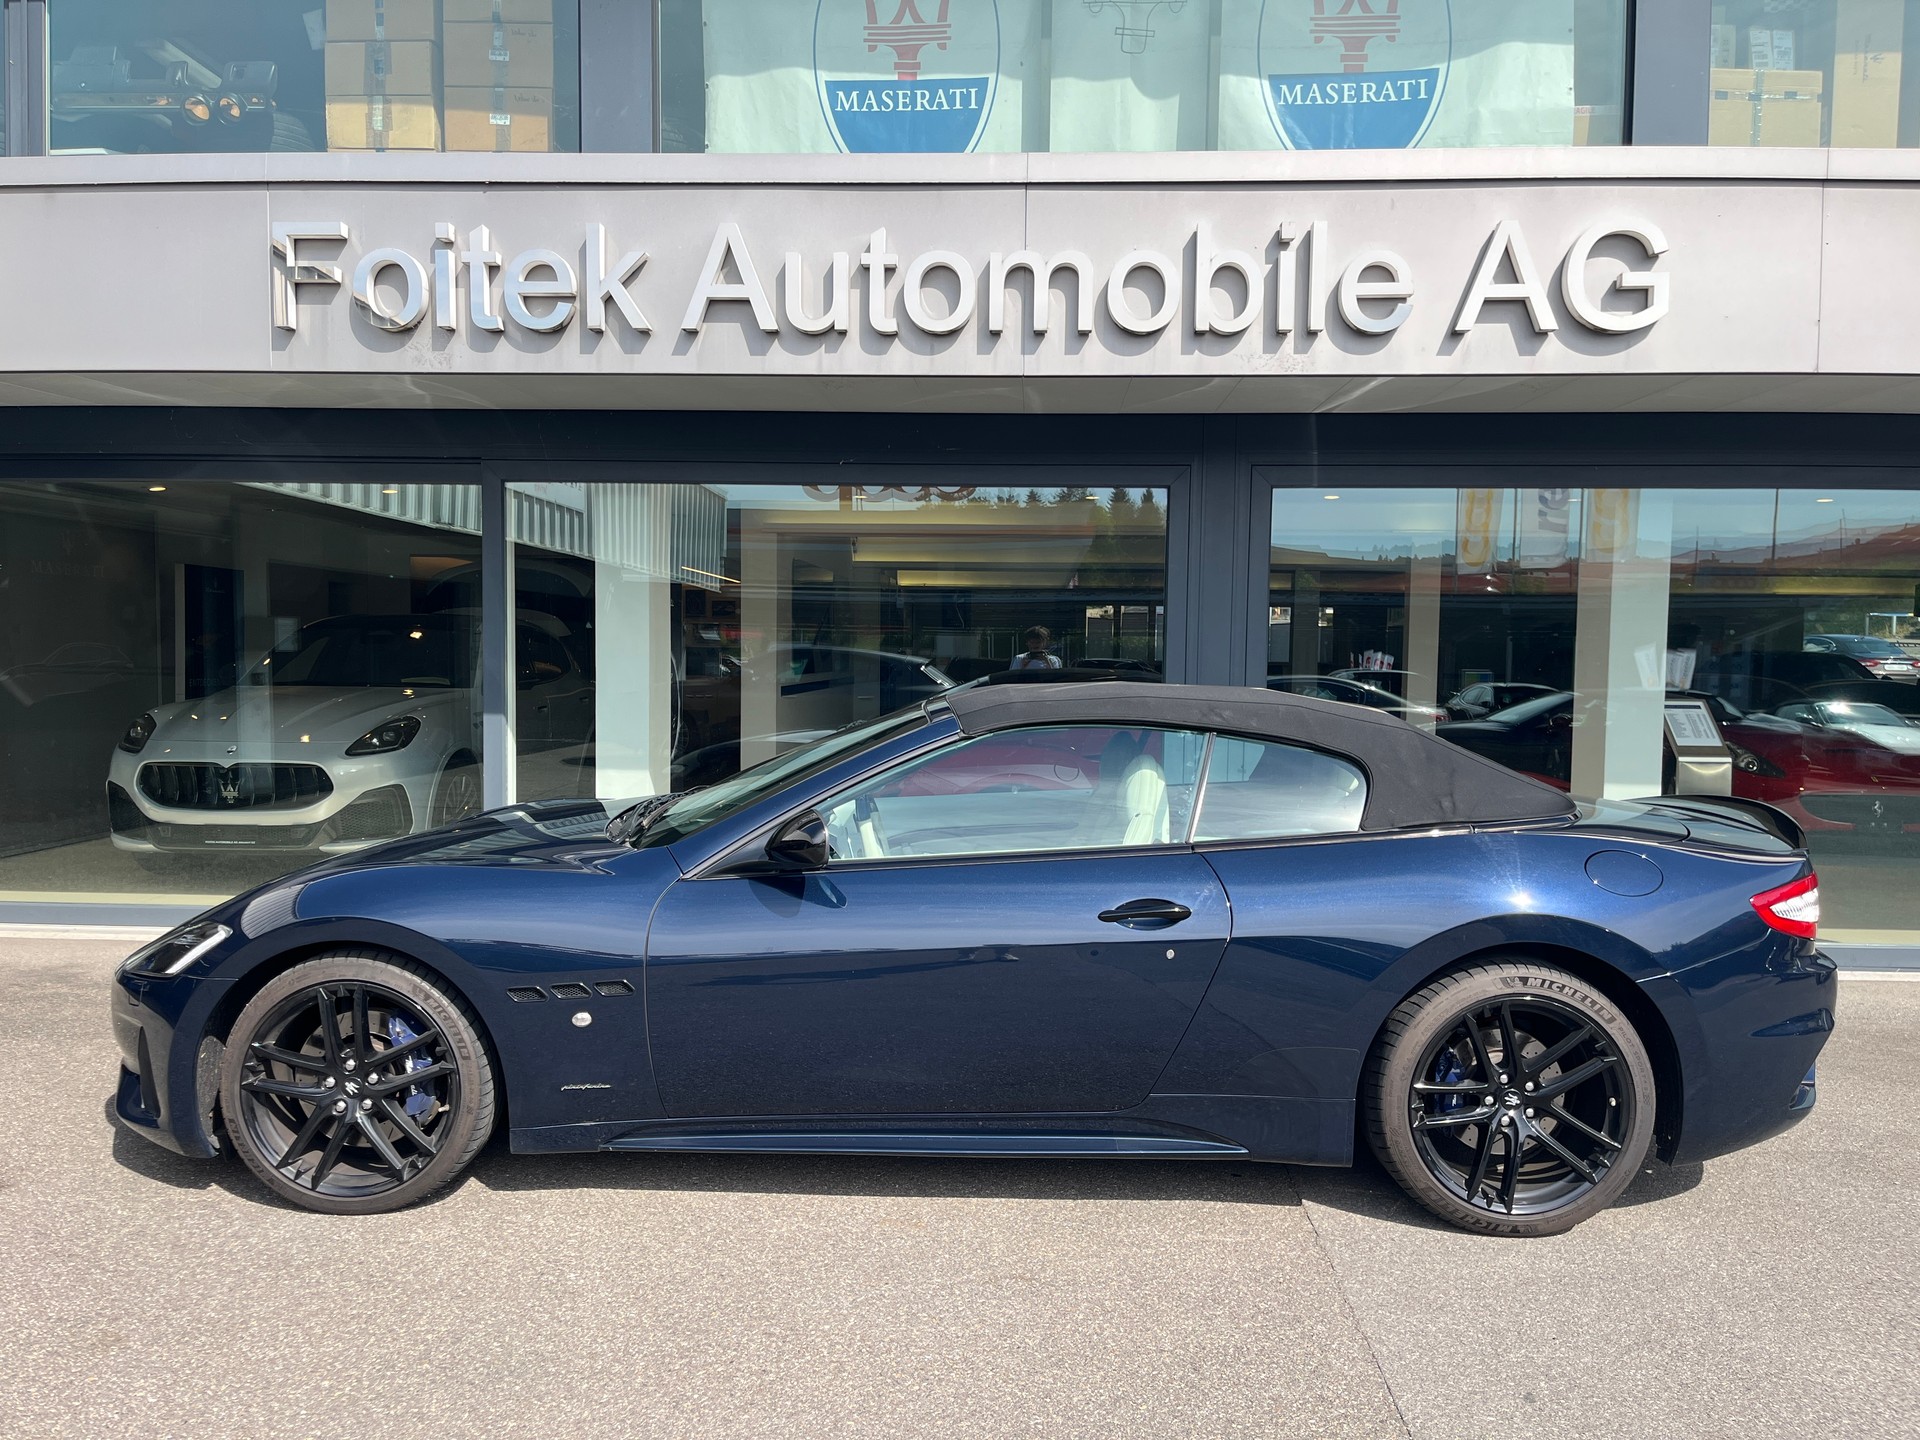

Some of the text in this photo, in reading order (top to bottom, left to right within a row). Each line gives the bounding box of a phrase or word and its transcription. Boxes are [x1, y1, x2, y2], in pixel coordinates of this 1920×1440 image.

[834, 87, 979, 112] MASERATI
[1277, 79, 1429, 106] MASERATI
[272, 219, 1670, 336] Foitek Automobile AG
[1526, 977, 1614, 1023] MICHELIN
